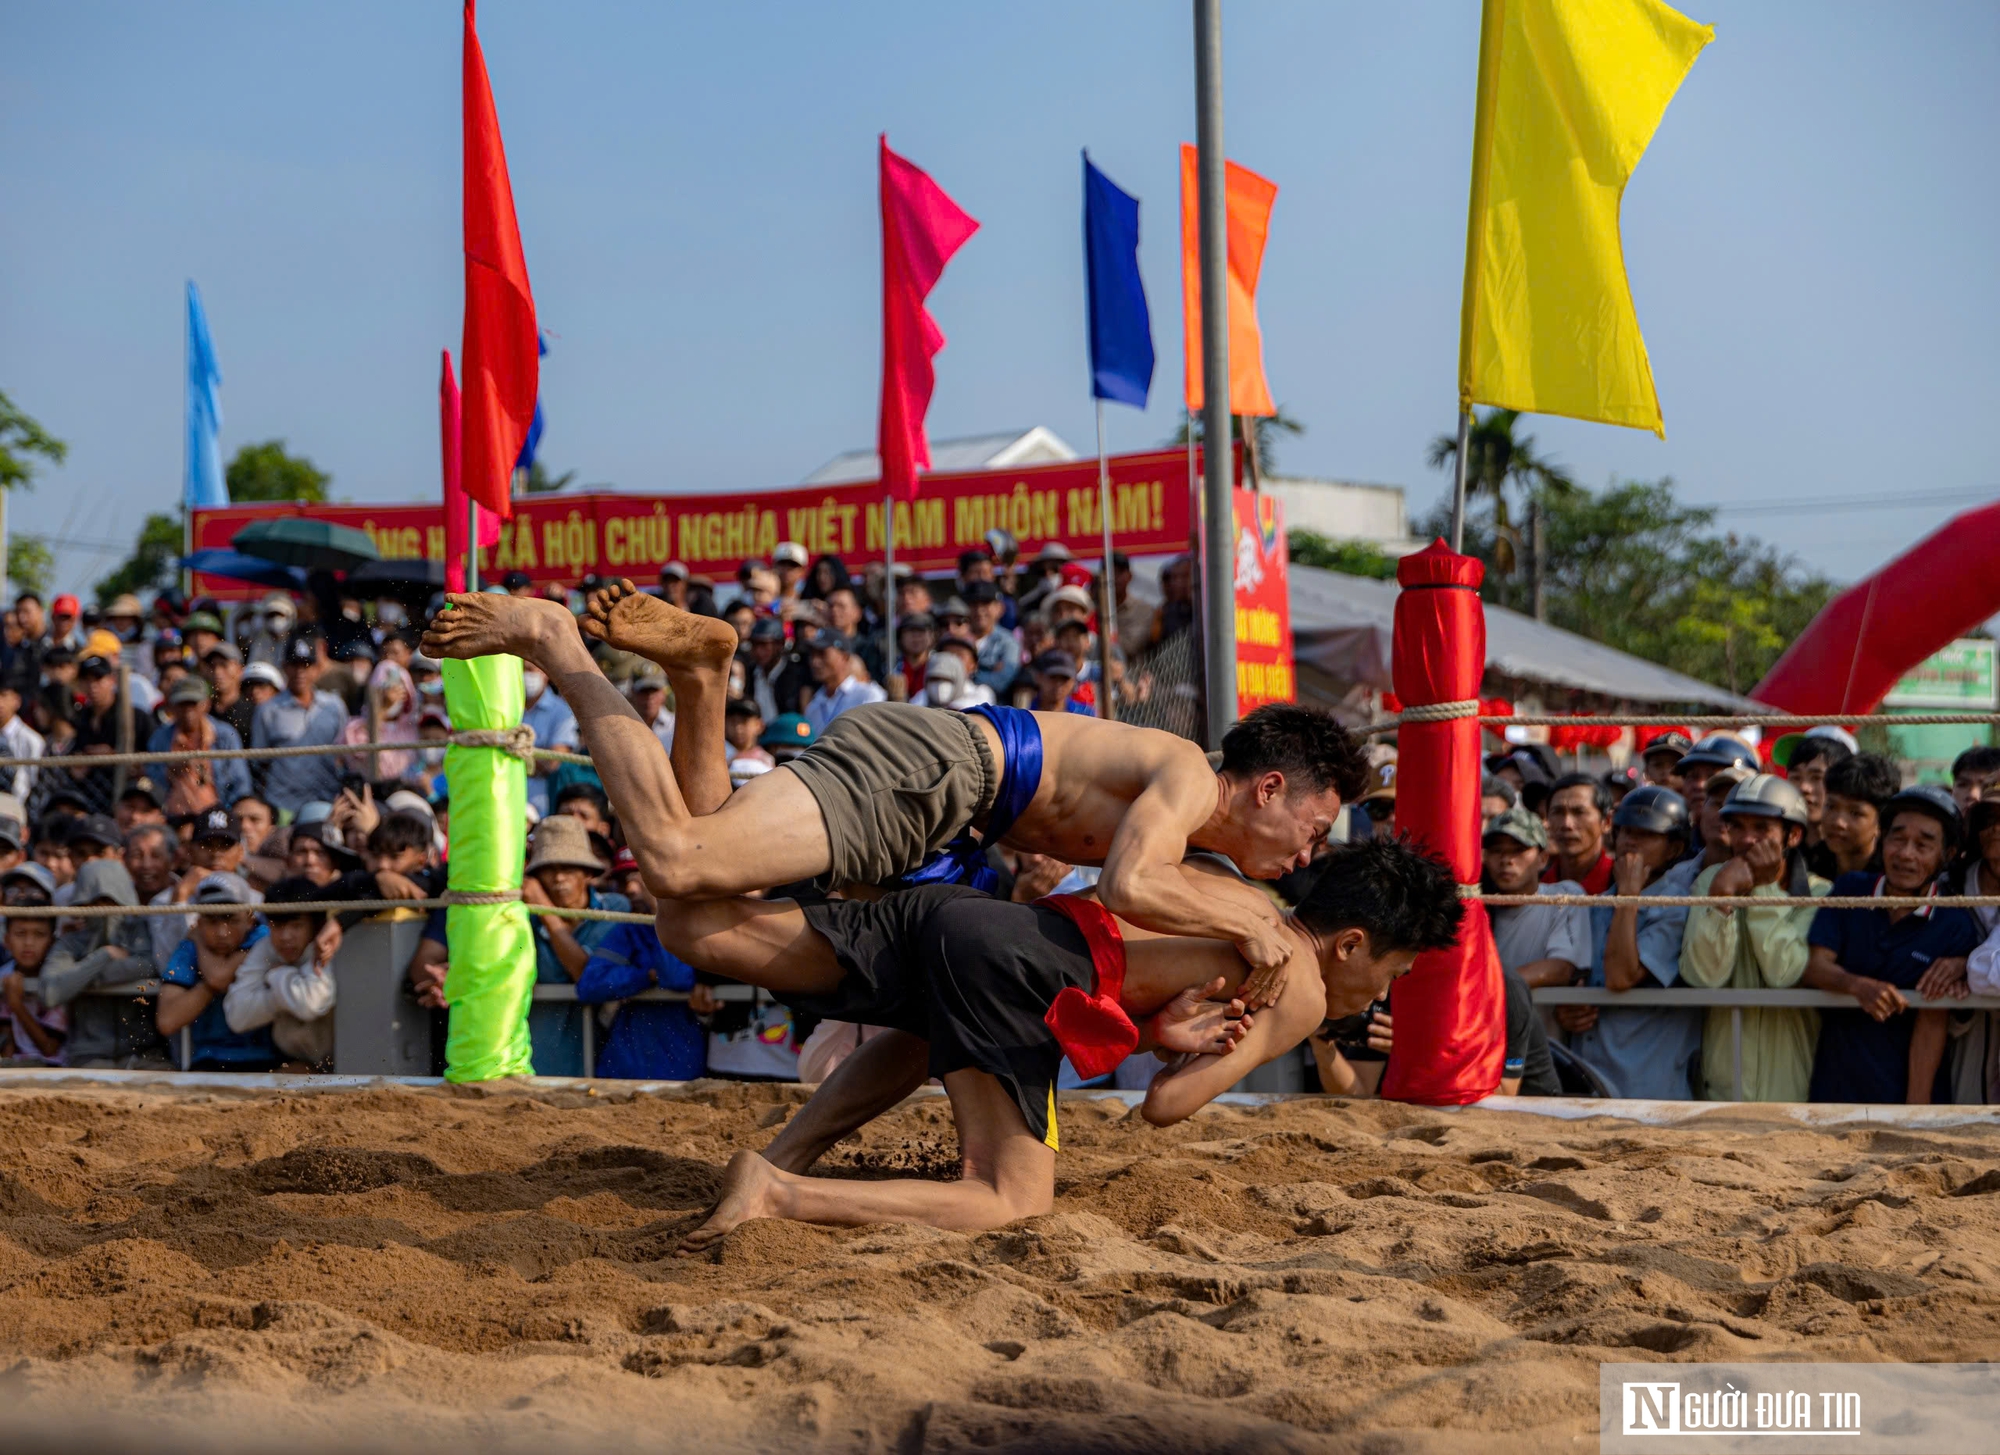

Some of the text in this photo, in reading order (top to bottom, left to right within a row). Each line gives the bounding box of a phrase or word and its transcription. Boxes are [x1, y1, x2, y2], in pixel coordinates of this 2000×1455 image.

[543, 510, 597, 577] HỘI
[605, 501, 671, 566] CHỦ
[678, 503, 778, 562] NGHĨA
[865, 497, 946, 552] NAM
[954, 482, 1060, 547] MUÔN
